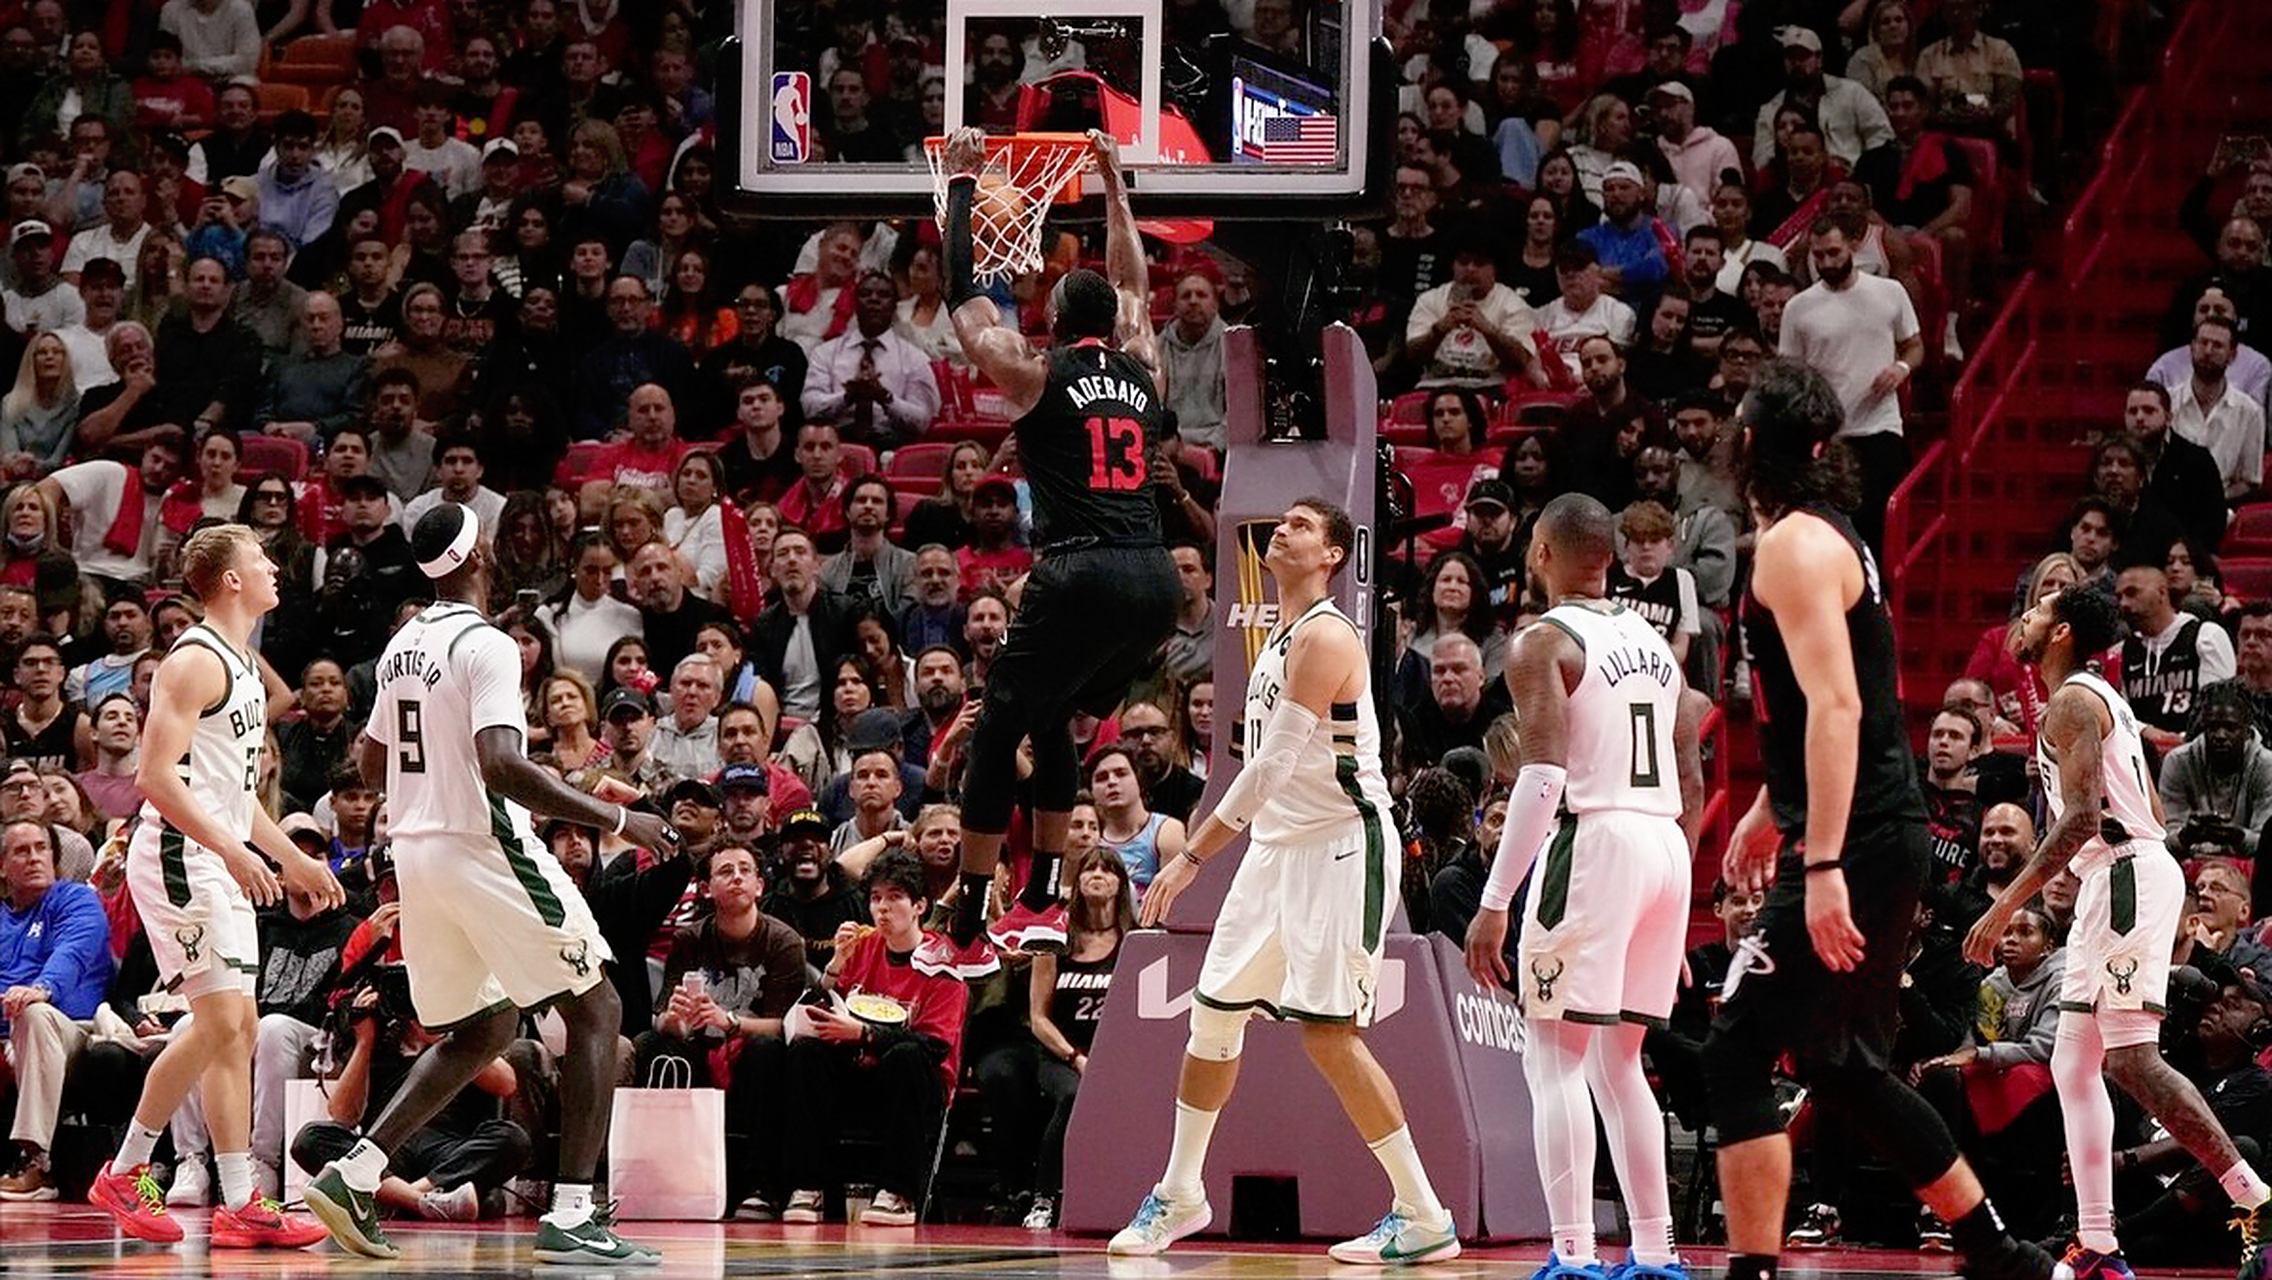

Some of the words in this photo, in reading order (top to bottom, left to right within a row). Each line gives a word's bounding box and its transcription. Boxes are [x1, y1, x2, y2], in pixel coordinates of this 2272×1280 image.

[775, 142, 794, 157] NBA
[1066, 375, 1149, 413] ADEBAYO
[1084, 416, 1147, 491] 13
[1227, 602, 1280, 628] HE
[422, 661, 442, 693] JR
[1599, 647, 1673, 688] LILLARD
[2129, 669, 2194, 699] MIAMI
[229, 698, 262, 739] BUC
[2161, 691, 2191, 715] 13
[398, 699, 425, 774] 9
[1629, 702, 1660, 788] 0
[1056, 972, 1113, 990] MIAM
[1456, 985, 1526, 1054] coinbas
